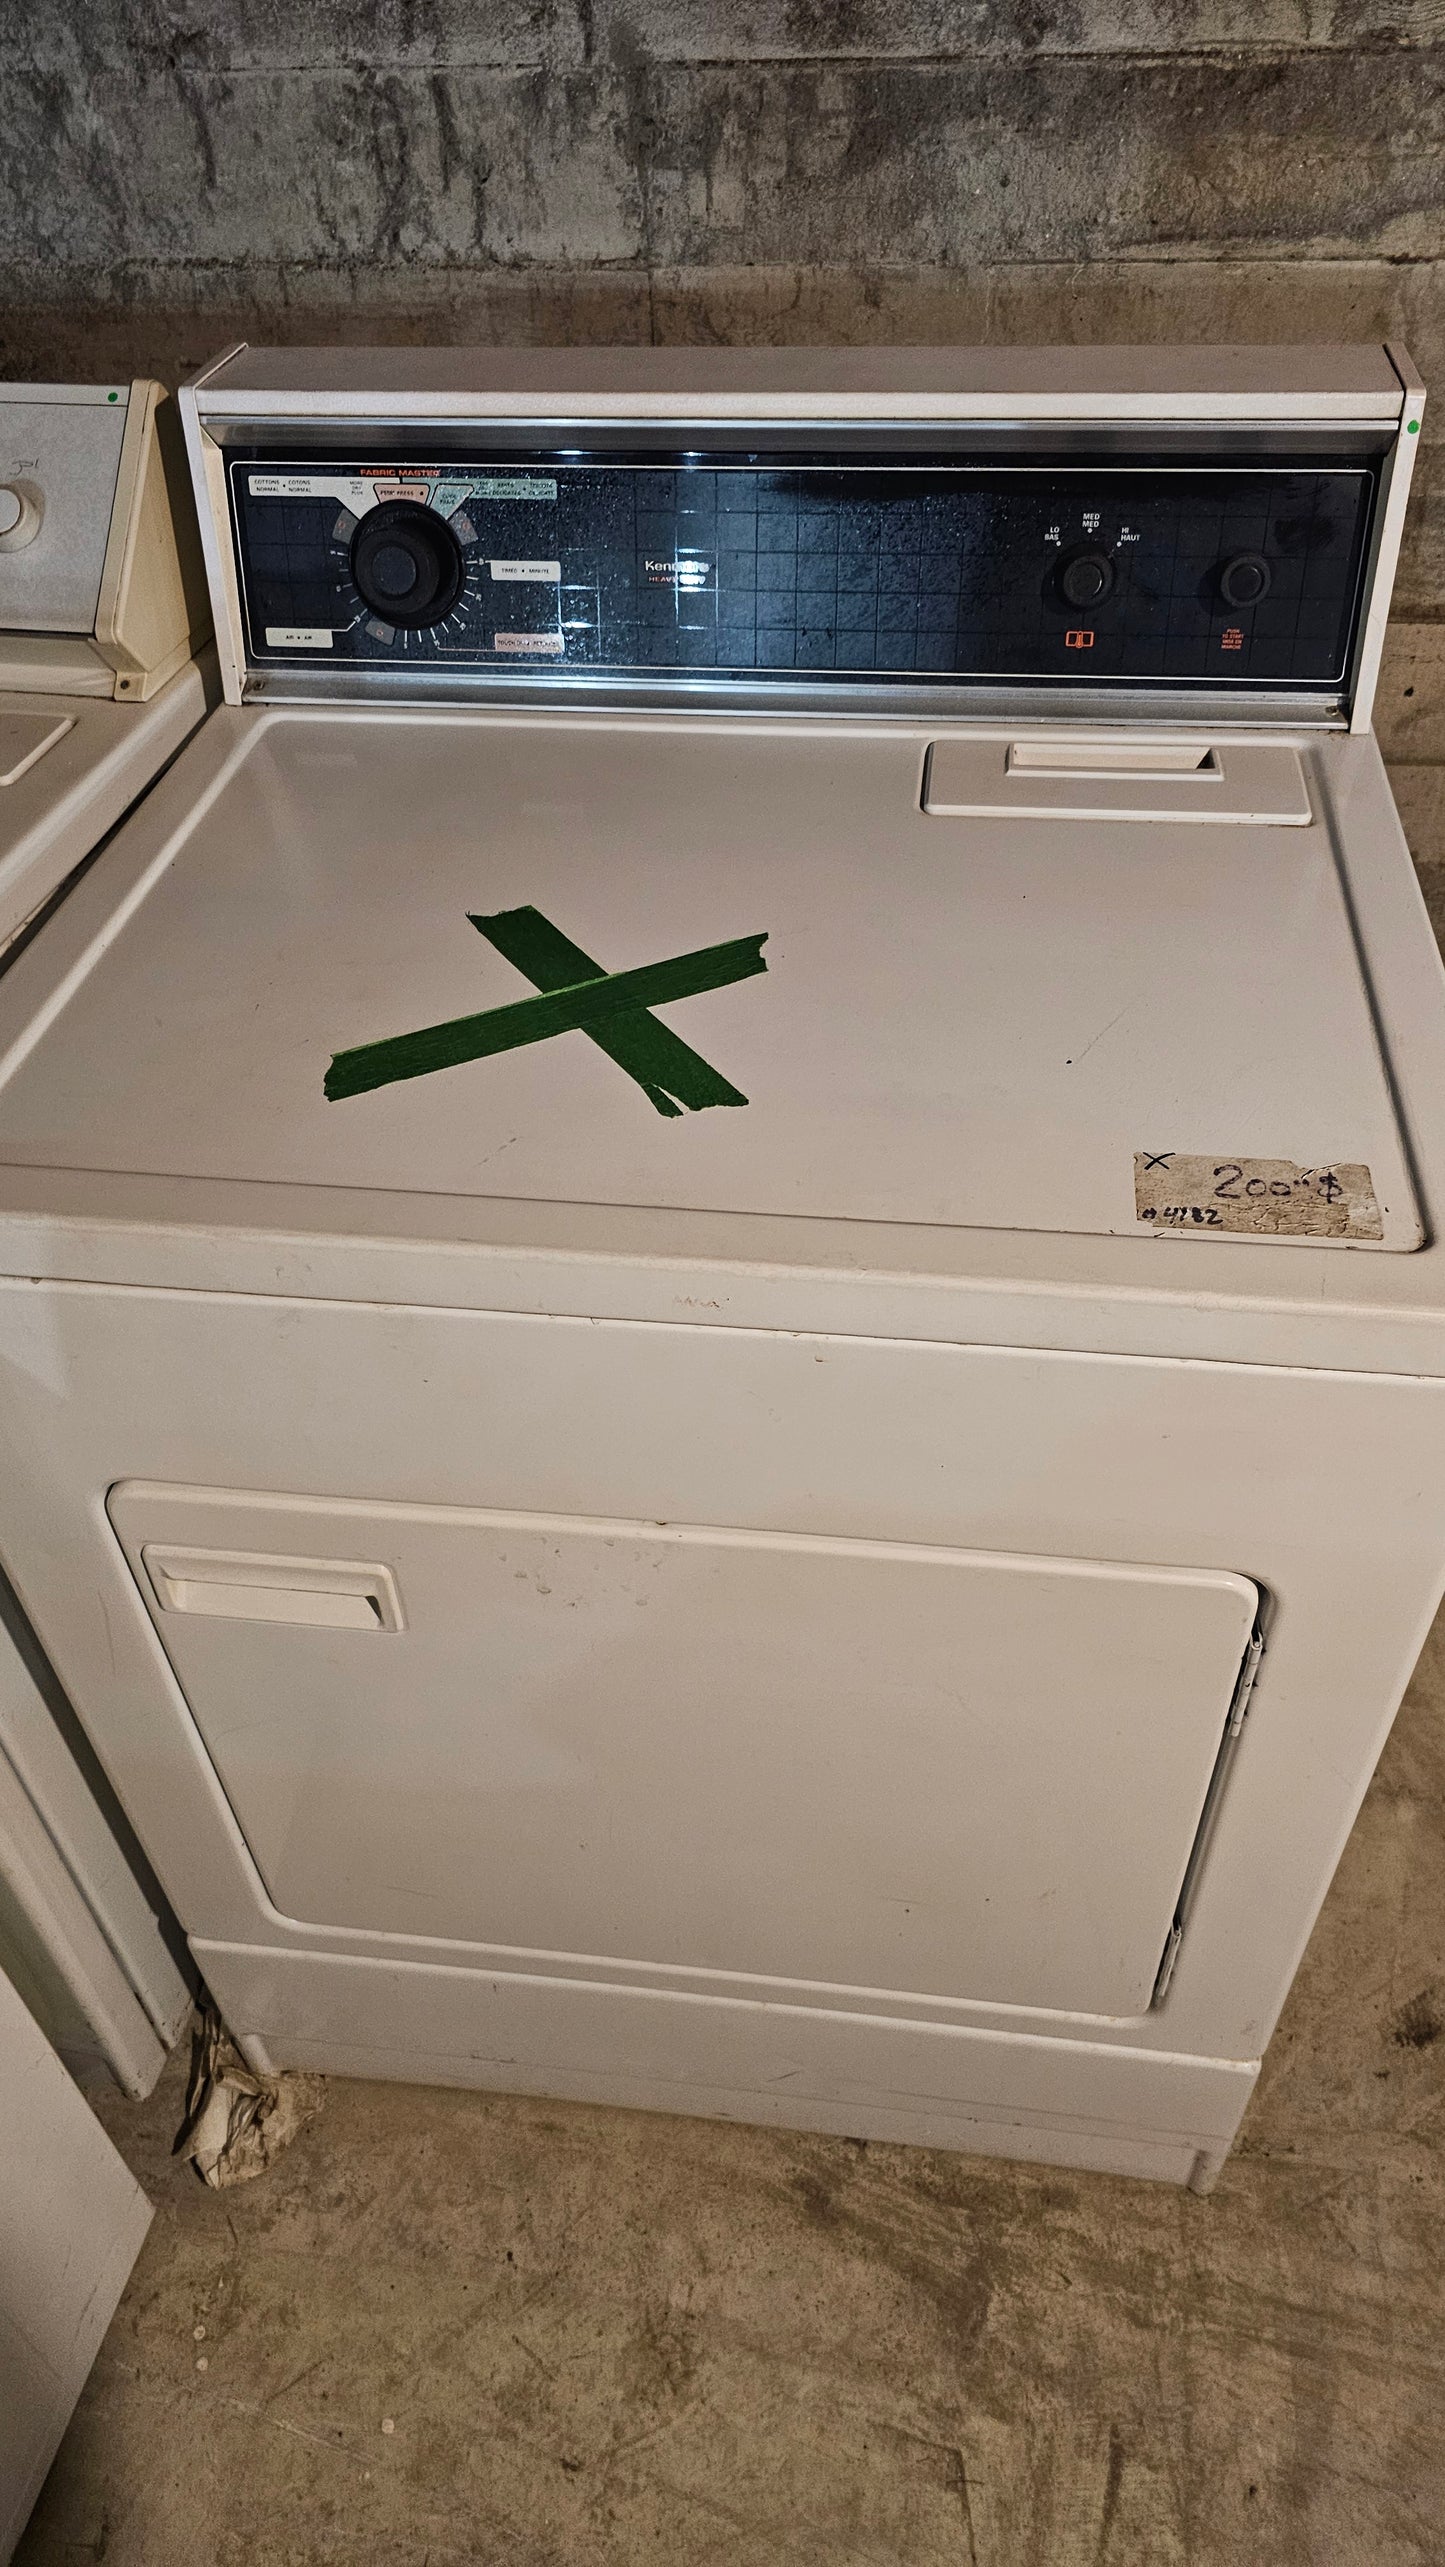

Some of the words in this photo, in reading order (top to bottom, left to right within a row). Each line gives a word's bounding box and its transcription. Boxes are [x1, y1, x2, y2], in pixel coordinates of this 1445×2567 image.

[398, 469, 440, 477] MASTER
[1082, 520, 1100, 528] MED
[1044, 533, 1059, 541] BAS
